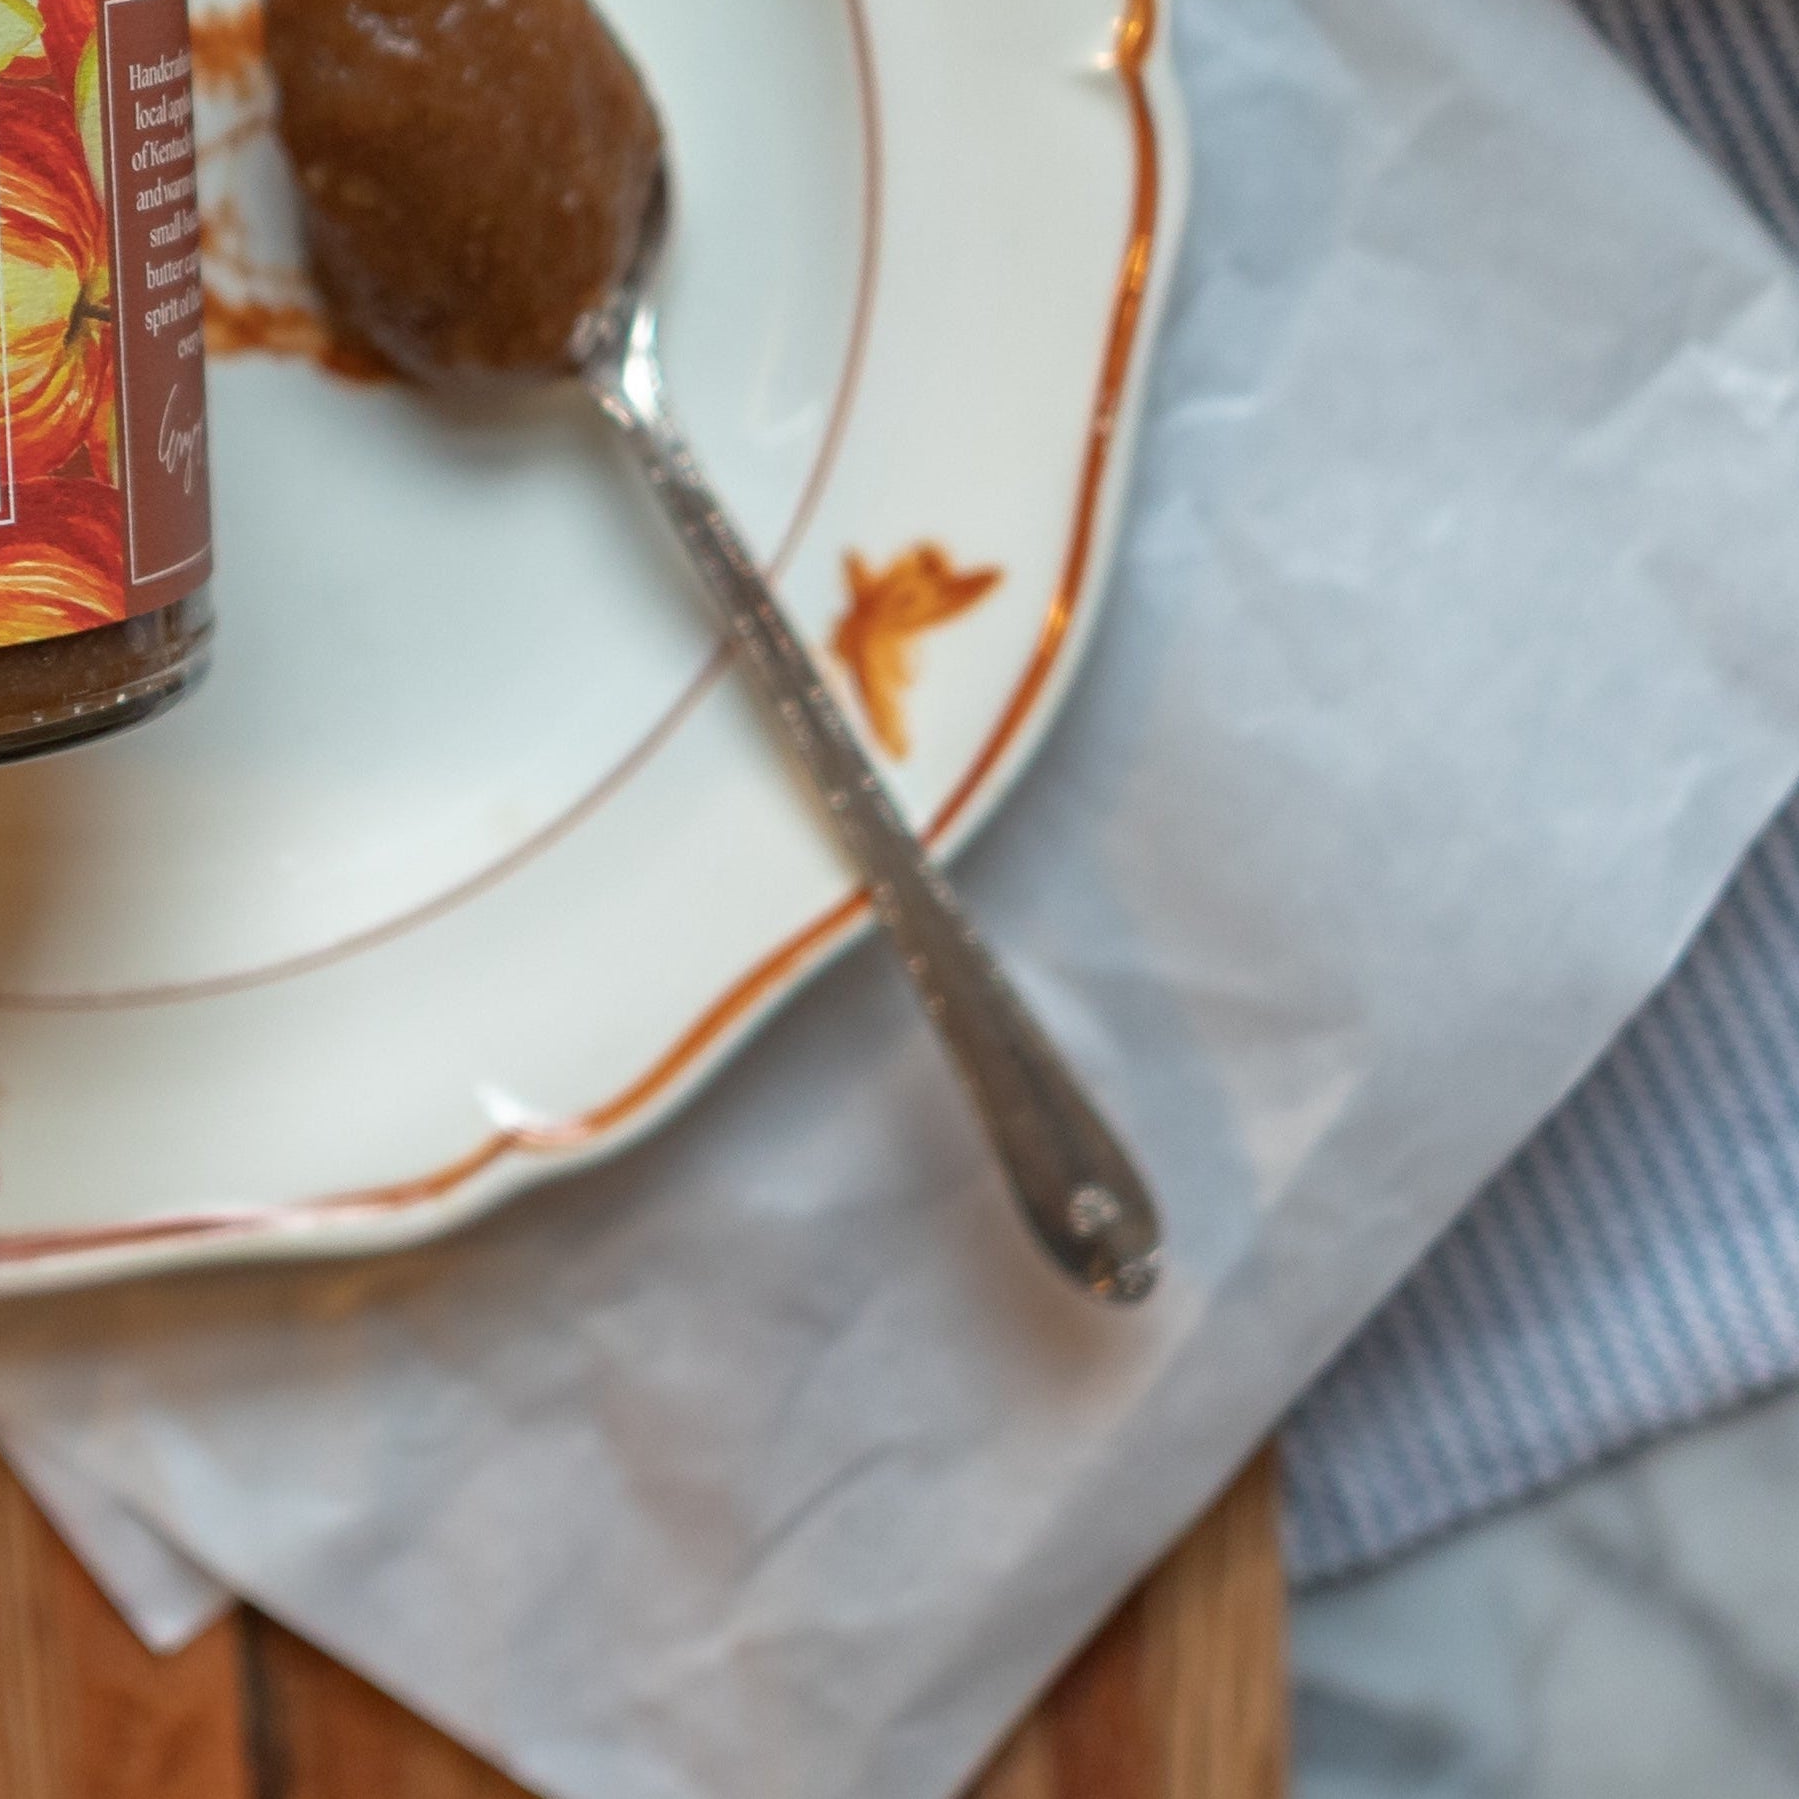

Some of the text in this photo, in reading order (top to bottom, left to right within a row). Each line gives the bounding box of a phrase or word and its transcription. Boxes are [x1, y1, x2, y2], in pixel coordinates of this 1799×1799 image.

[135, 93, 167, 130] local
[131, 127, 193, 171] of Kentuck
[136, 176, 163, 212] and
[145, 257, 182, 290] butter
[144, 297, 178, 337] spirit
